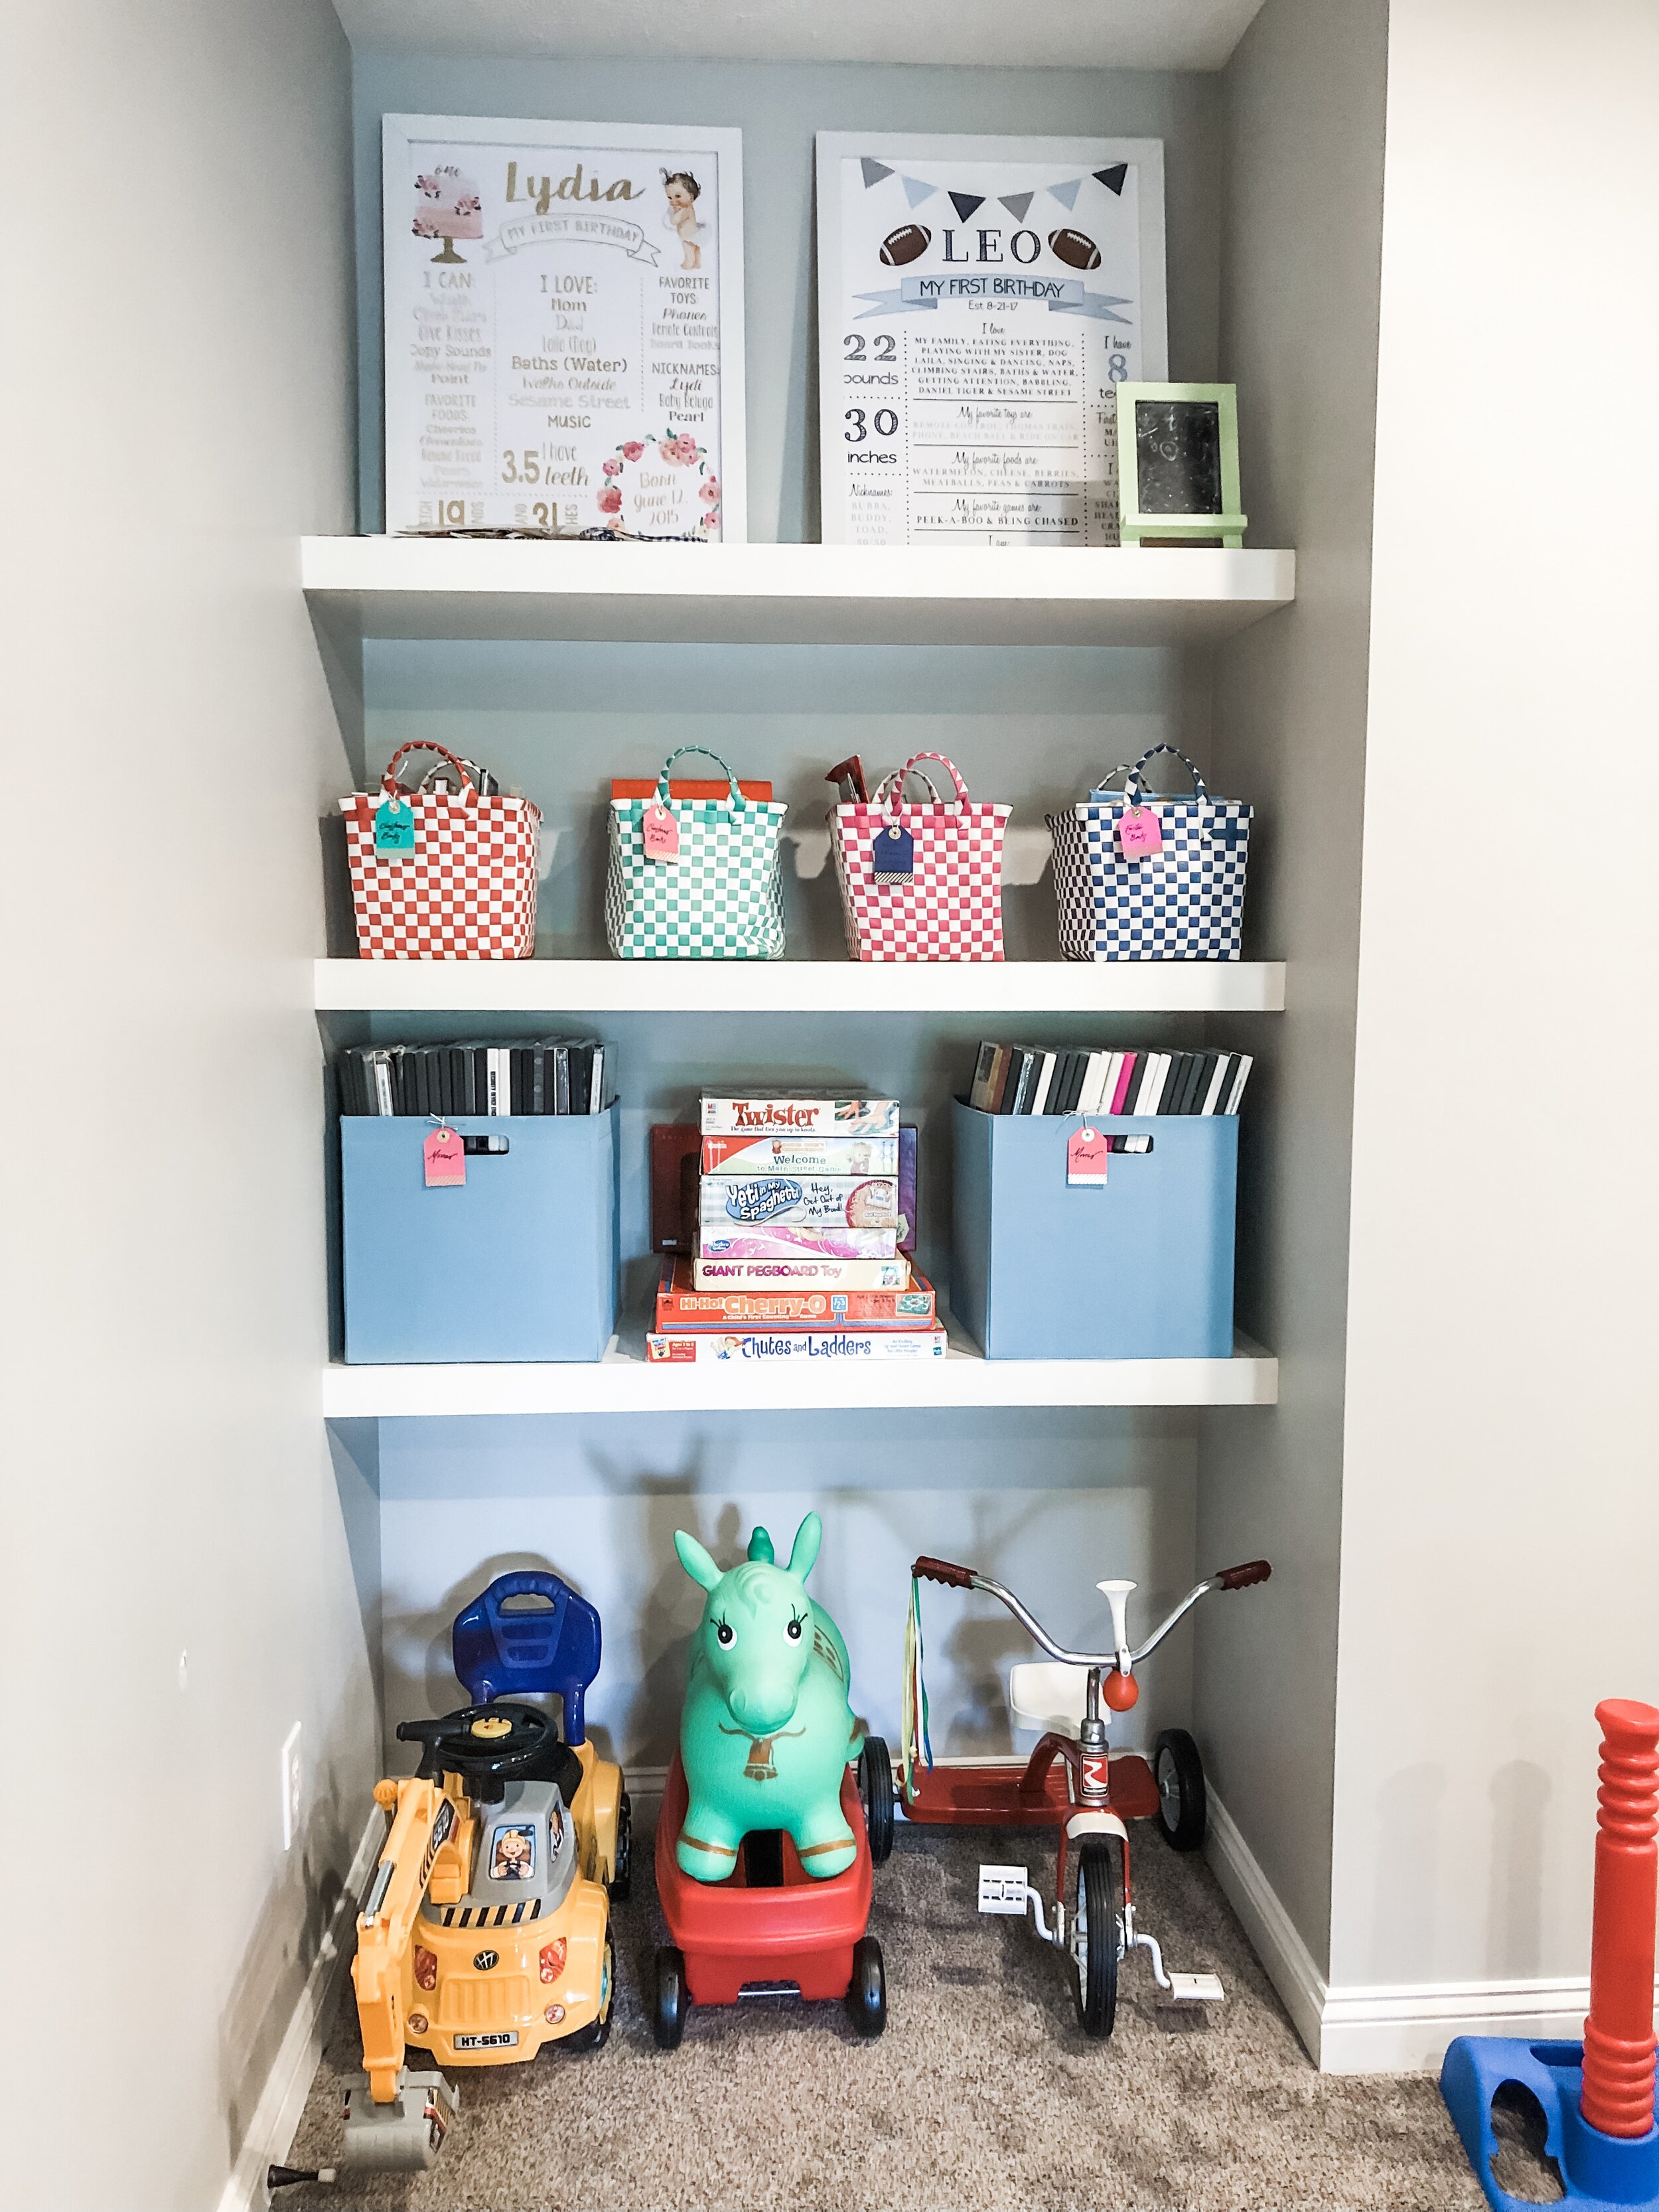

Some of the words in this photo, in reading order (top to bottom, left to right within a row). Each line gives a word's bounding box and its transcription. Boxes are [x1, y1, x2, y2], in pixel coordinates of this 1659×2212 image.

[505, 161, 646, 215] Lydia
[508, 226, 526, 240] MY
[532, 220, 569, 234] FIRST
[575, 220, 640, 241] BIRTHDAY
[942, 229, 1041, 264] LEO
[423, 271, 431, 288] I
[541, 275, 548, 293] I
[555, 275, 598, 295] LOVE:
[659, 276, 710, 290] FAVORITE
[920, 280, 945, 297] MY
[950, 278, 988, 295] FIRST
[993, 277, 1065, 298] BIRTHDAY
[551, 298, 587, 312] Mom
[968, 299, 983, 310] Est
[987, 301, 1018, 311] 8-21-17
[981, 323, 987, 334] I
[843, 334, 897, 362] 22
[1104, 335, 1110, 349] I
[512, 356, 559, 371] Baths
[564, 356, 628, 373] (Water)
[1108, 354, 1128, 382] 8
[669, 411, 704, 422] Pearl
[845, 408, 899, 442] 30
[549, 441, 577, 462] have
[847, 451, 897, 463] inches
[502, 449, 541, 484] 3.5
[545, 466, 589, 486] teeth
[640, 472, 676, 488] Born
[917, 516, 983, 524] PEEK-A-BOO
[1035, 517, 1079, 526] CHASED
[732, 1102, 820, 1127] Twister
[774, 1155, 826, 1165] Welcome
[726, 1183, 760, 1207] Yeti
[768, 1181, 780, 1191] My
[811, 1183, 833, 1195] Hey,
[740, 1186, 800, 1220] Spaghetti
[804, 1196, 818, 1206] Get
[809, 1207, 822, 1217] My
[702, 1265, 744, 1277] GIANT
[747, 1266, 818, 1277] PEGBOARD
[821, 1266, 842, 1278] Toy
[680, 1297, 723, 1311] Hi-Ho!
[724, 1294, 827, 1317] Cherry-O
[742, 1336, 792, 1359] Chutes
[808, 1335, 871, 1358] Ladders
[461, 2034, 510, 2046] HT-5610
